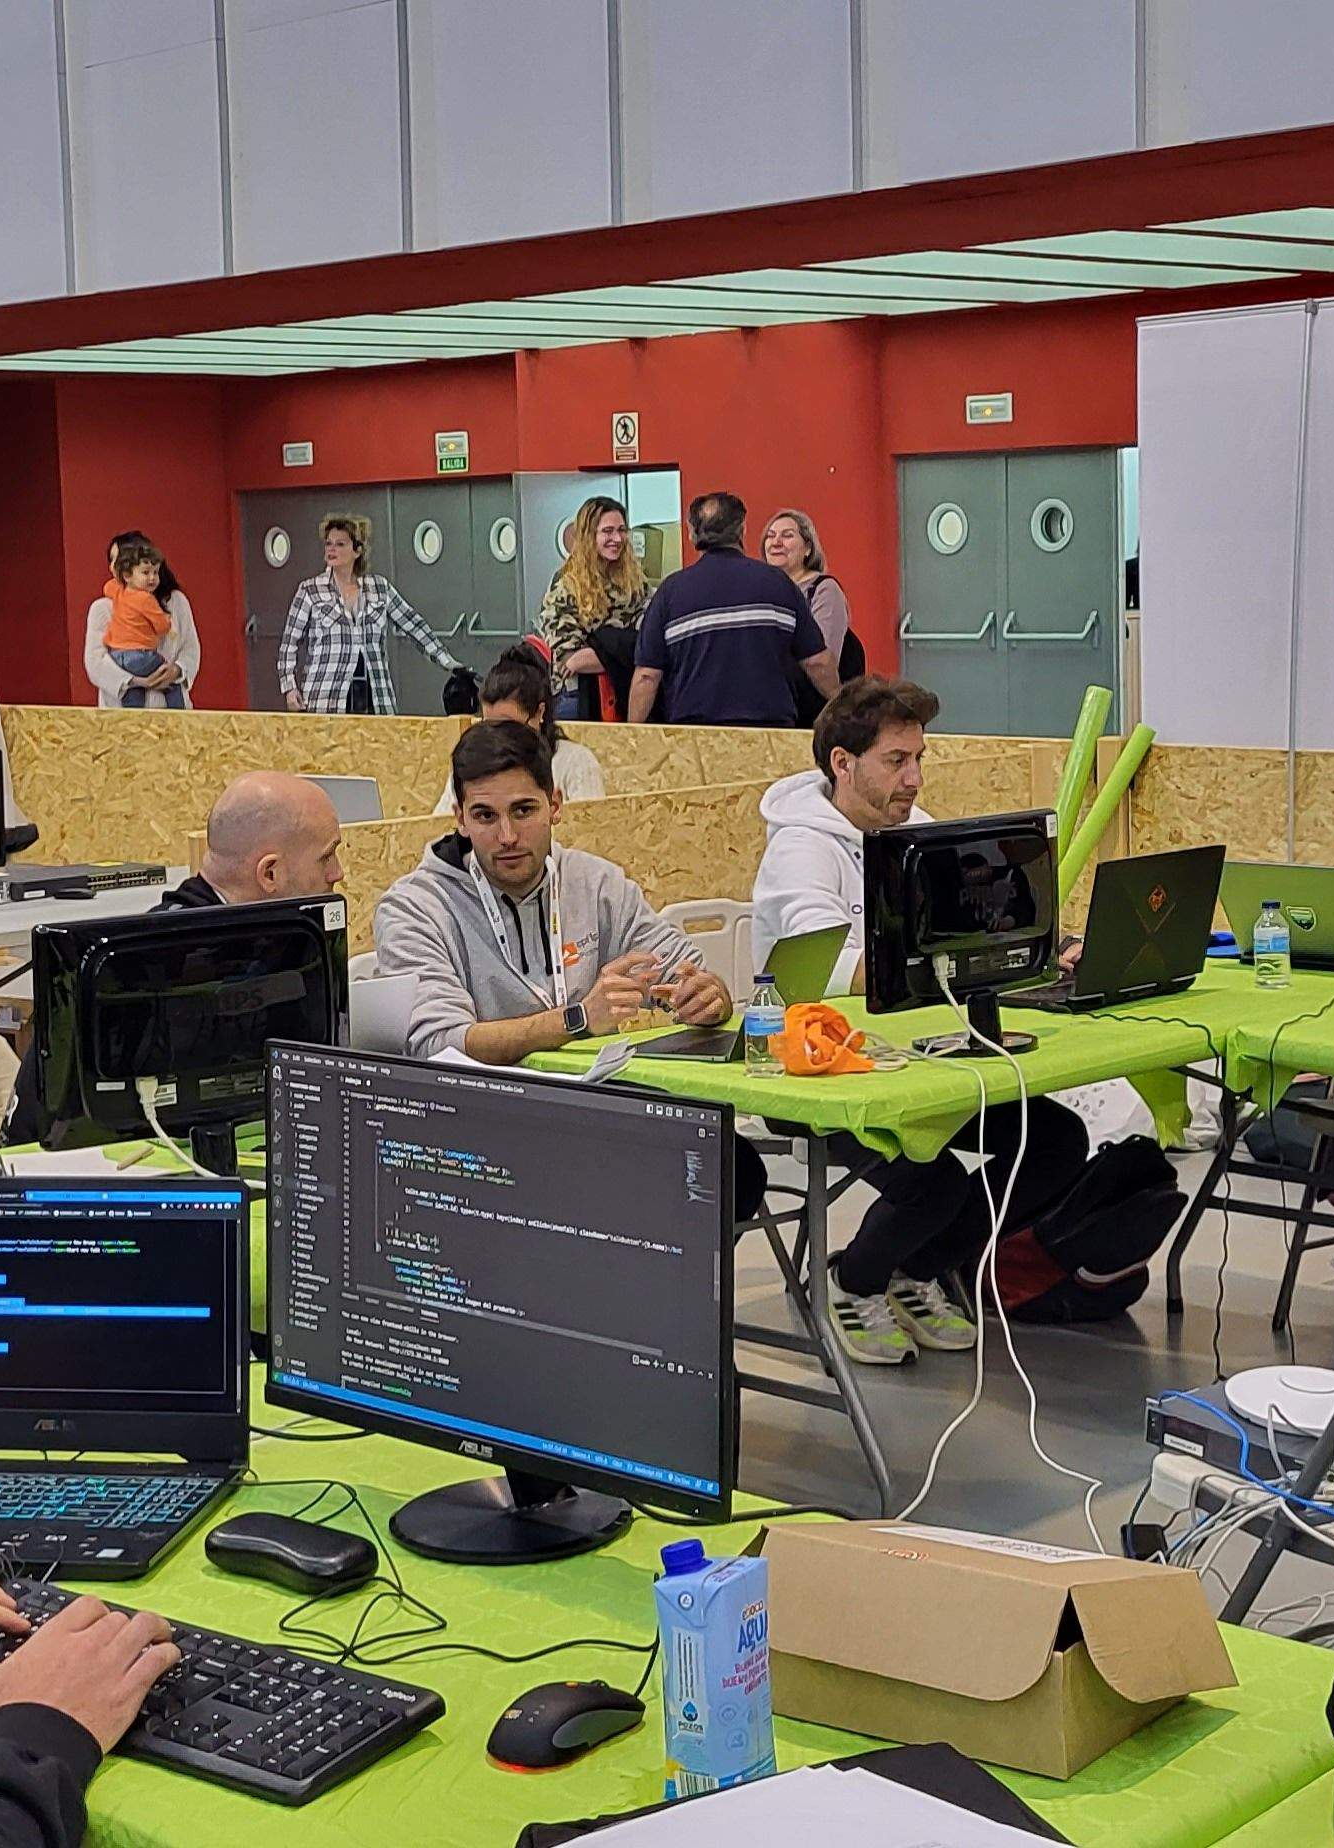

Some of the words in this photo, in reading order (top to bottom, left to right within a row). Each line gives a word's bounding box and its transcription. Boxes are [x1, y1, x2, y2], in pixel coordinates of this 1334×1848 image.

[441, 457, 465, 470] SALIDA
[329, 911, 341, 923] 26
[457, 1439, 494, 1459] ASUS
[381, 1687, 417, 1703] logitech
[678, 1720, 704, 1731] POZOS
